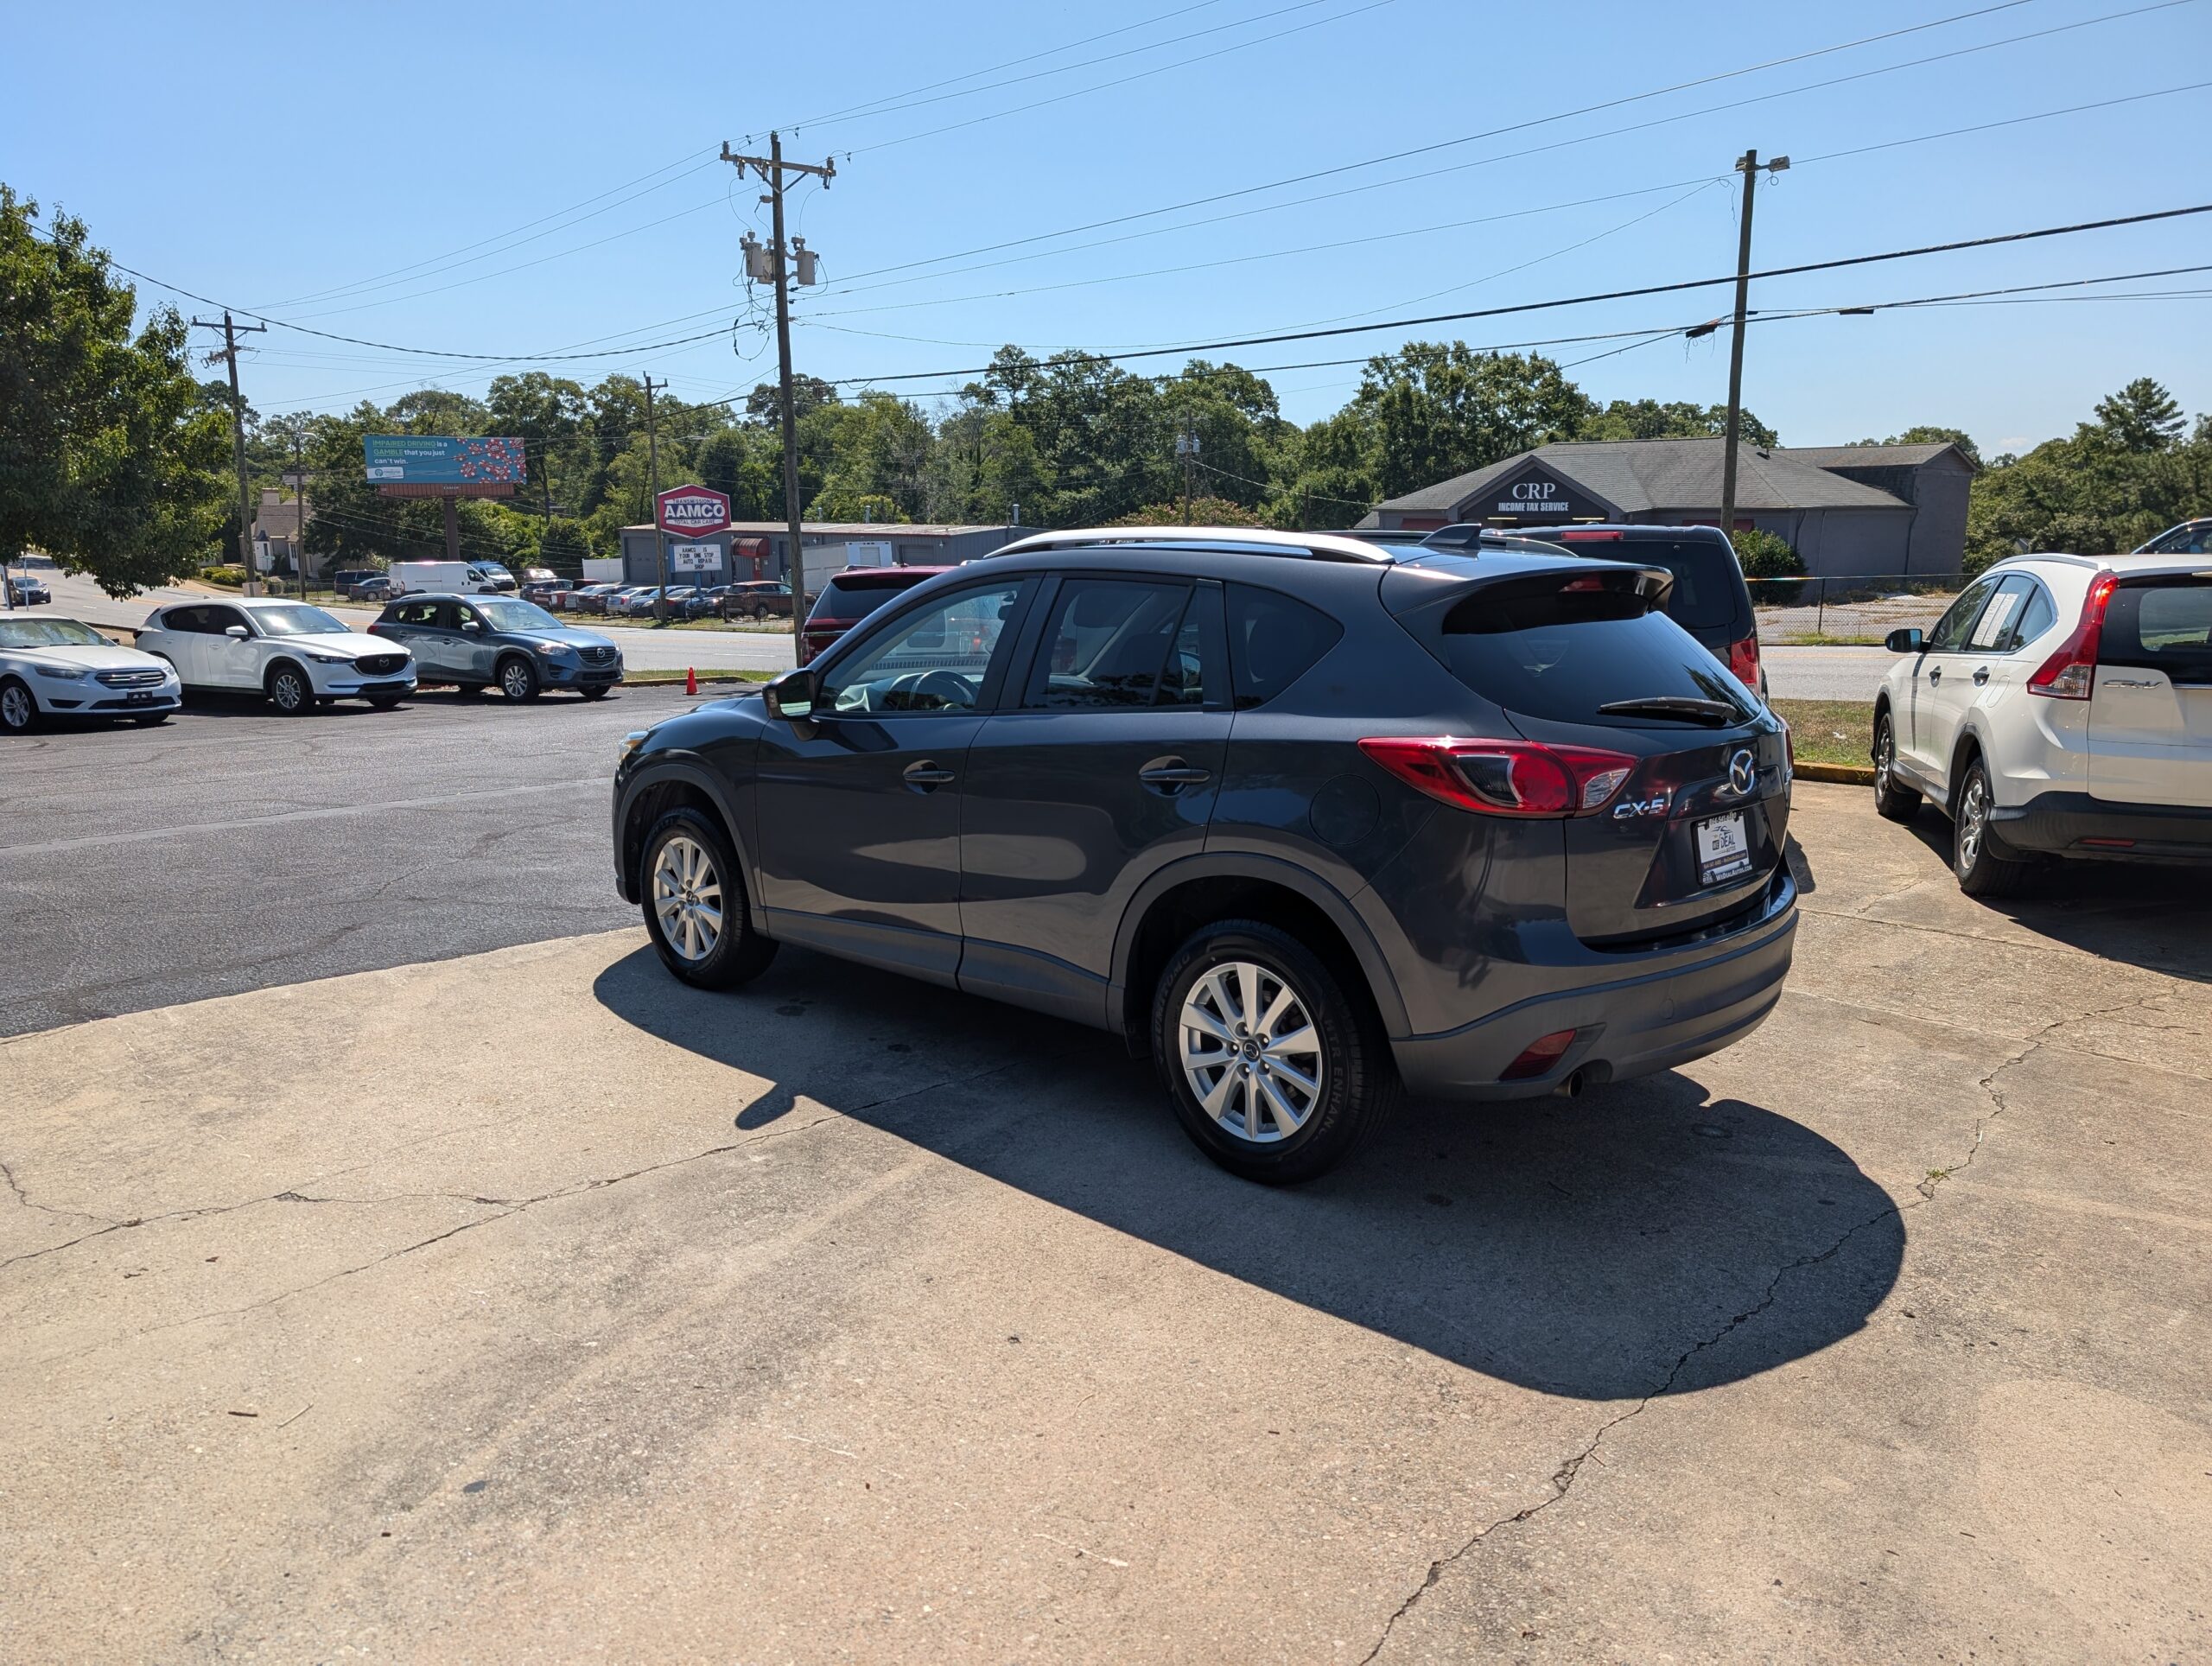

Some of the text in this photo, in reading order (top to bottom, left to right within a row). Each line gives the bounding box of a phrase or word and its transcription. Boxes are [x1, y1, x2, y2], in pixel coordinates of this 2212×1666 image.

[1512, 483, 1556, 499] CRP
[664, 504, 726, 517] AAMCO
[1498, 502, 1569, 511] INCOME TAX SERVICE
[2102, 678, 2163, 690] CR-V
[1613, 798, 1664, 819] CX-5
[1721, 832, 1735, 848] DEAL
